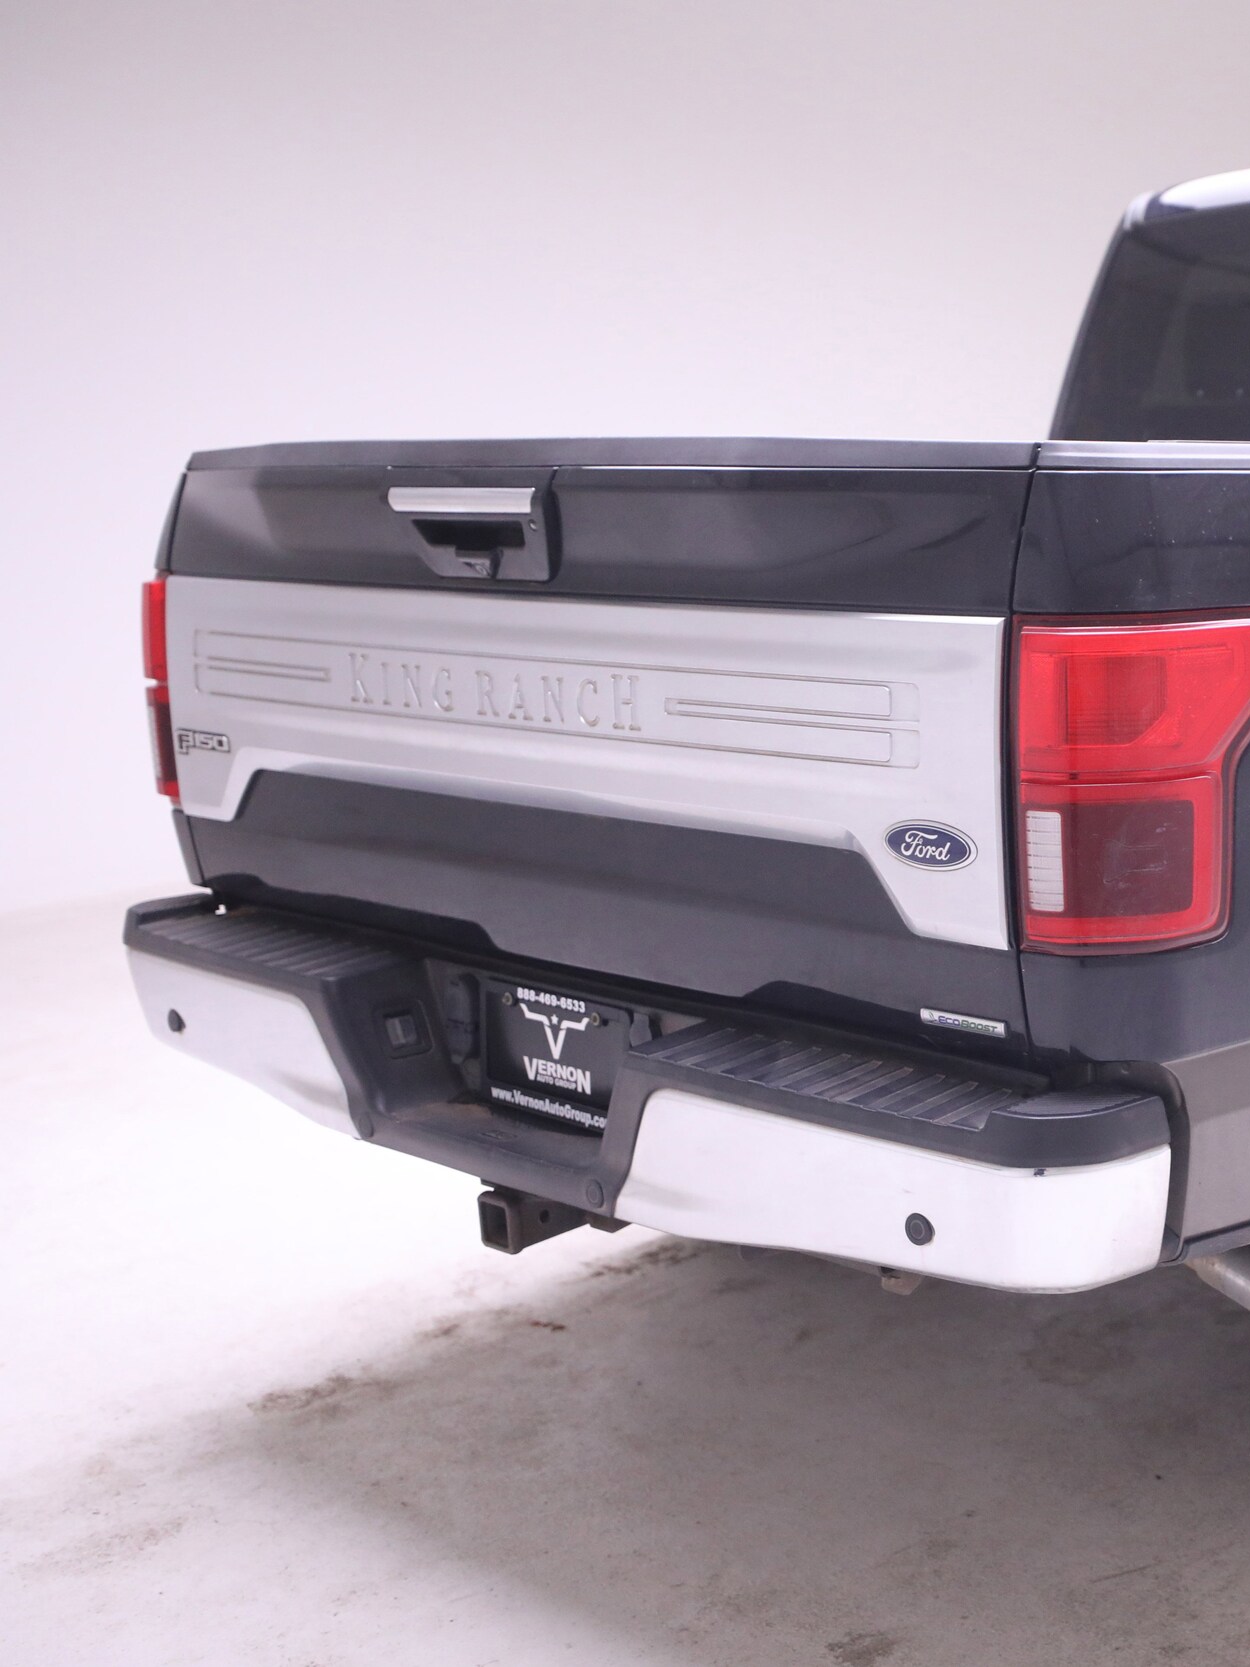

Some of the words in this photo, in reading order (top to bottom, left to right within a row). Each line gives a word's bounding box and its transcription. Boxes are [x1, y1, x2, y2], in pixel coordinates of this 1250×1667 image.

[348, 652, 454, 713] KING
[475, 670, 642, 731] RANCH
[901, 830, 951, 861] Ford
[517, 987, 585, 1013] 888-469-6533
[523, 1055, 591, 1095] VERNON
[536, 1074, 554, 1085] AUTO
[554, 1078, 576, 1090] GROUP
